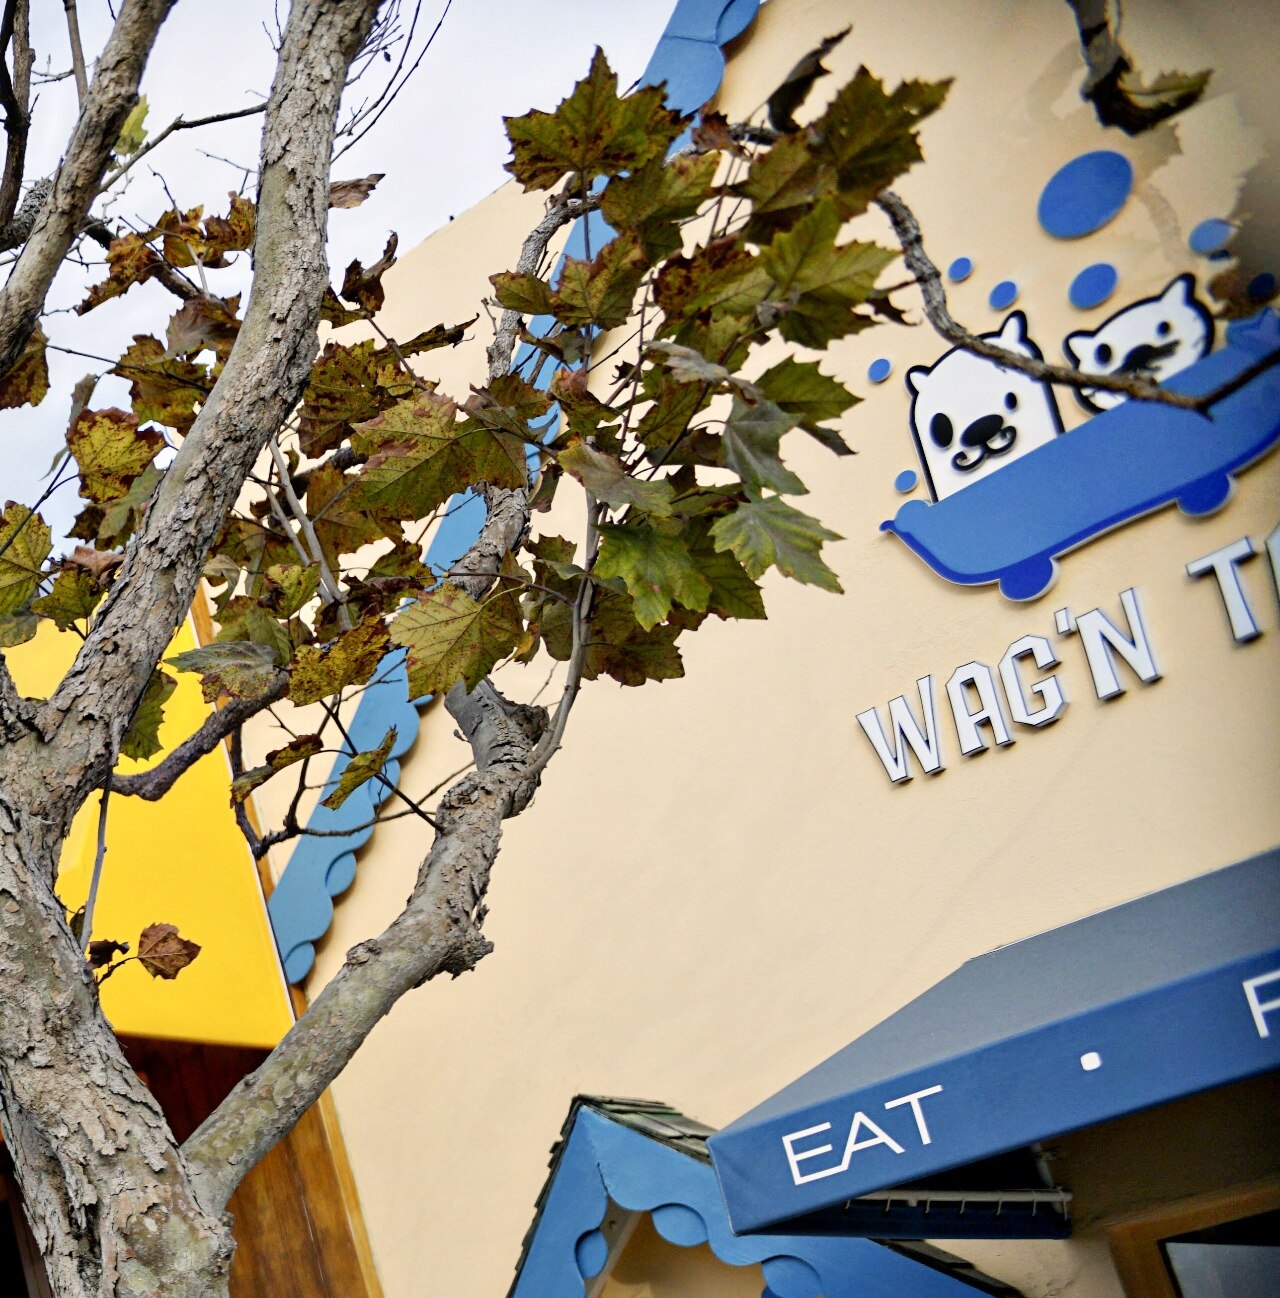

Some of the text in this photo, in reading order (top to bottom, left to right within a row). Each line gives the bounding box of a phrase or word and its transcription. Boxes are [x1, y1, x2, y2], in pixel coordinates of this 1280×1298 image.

[855, 521, 1280, 785] WAG'N T
[781, 1084, 944, 1186] EAT
